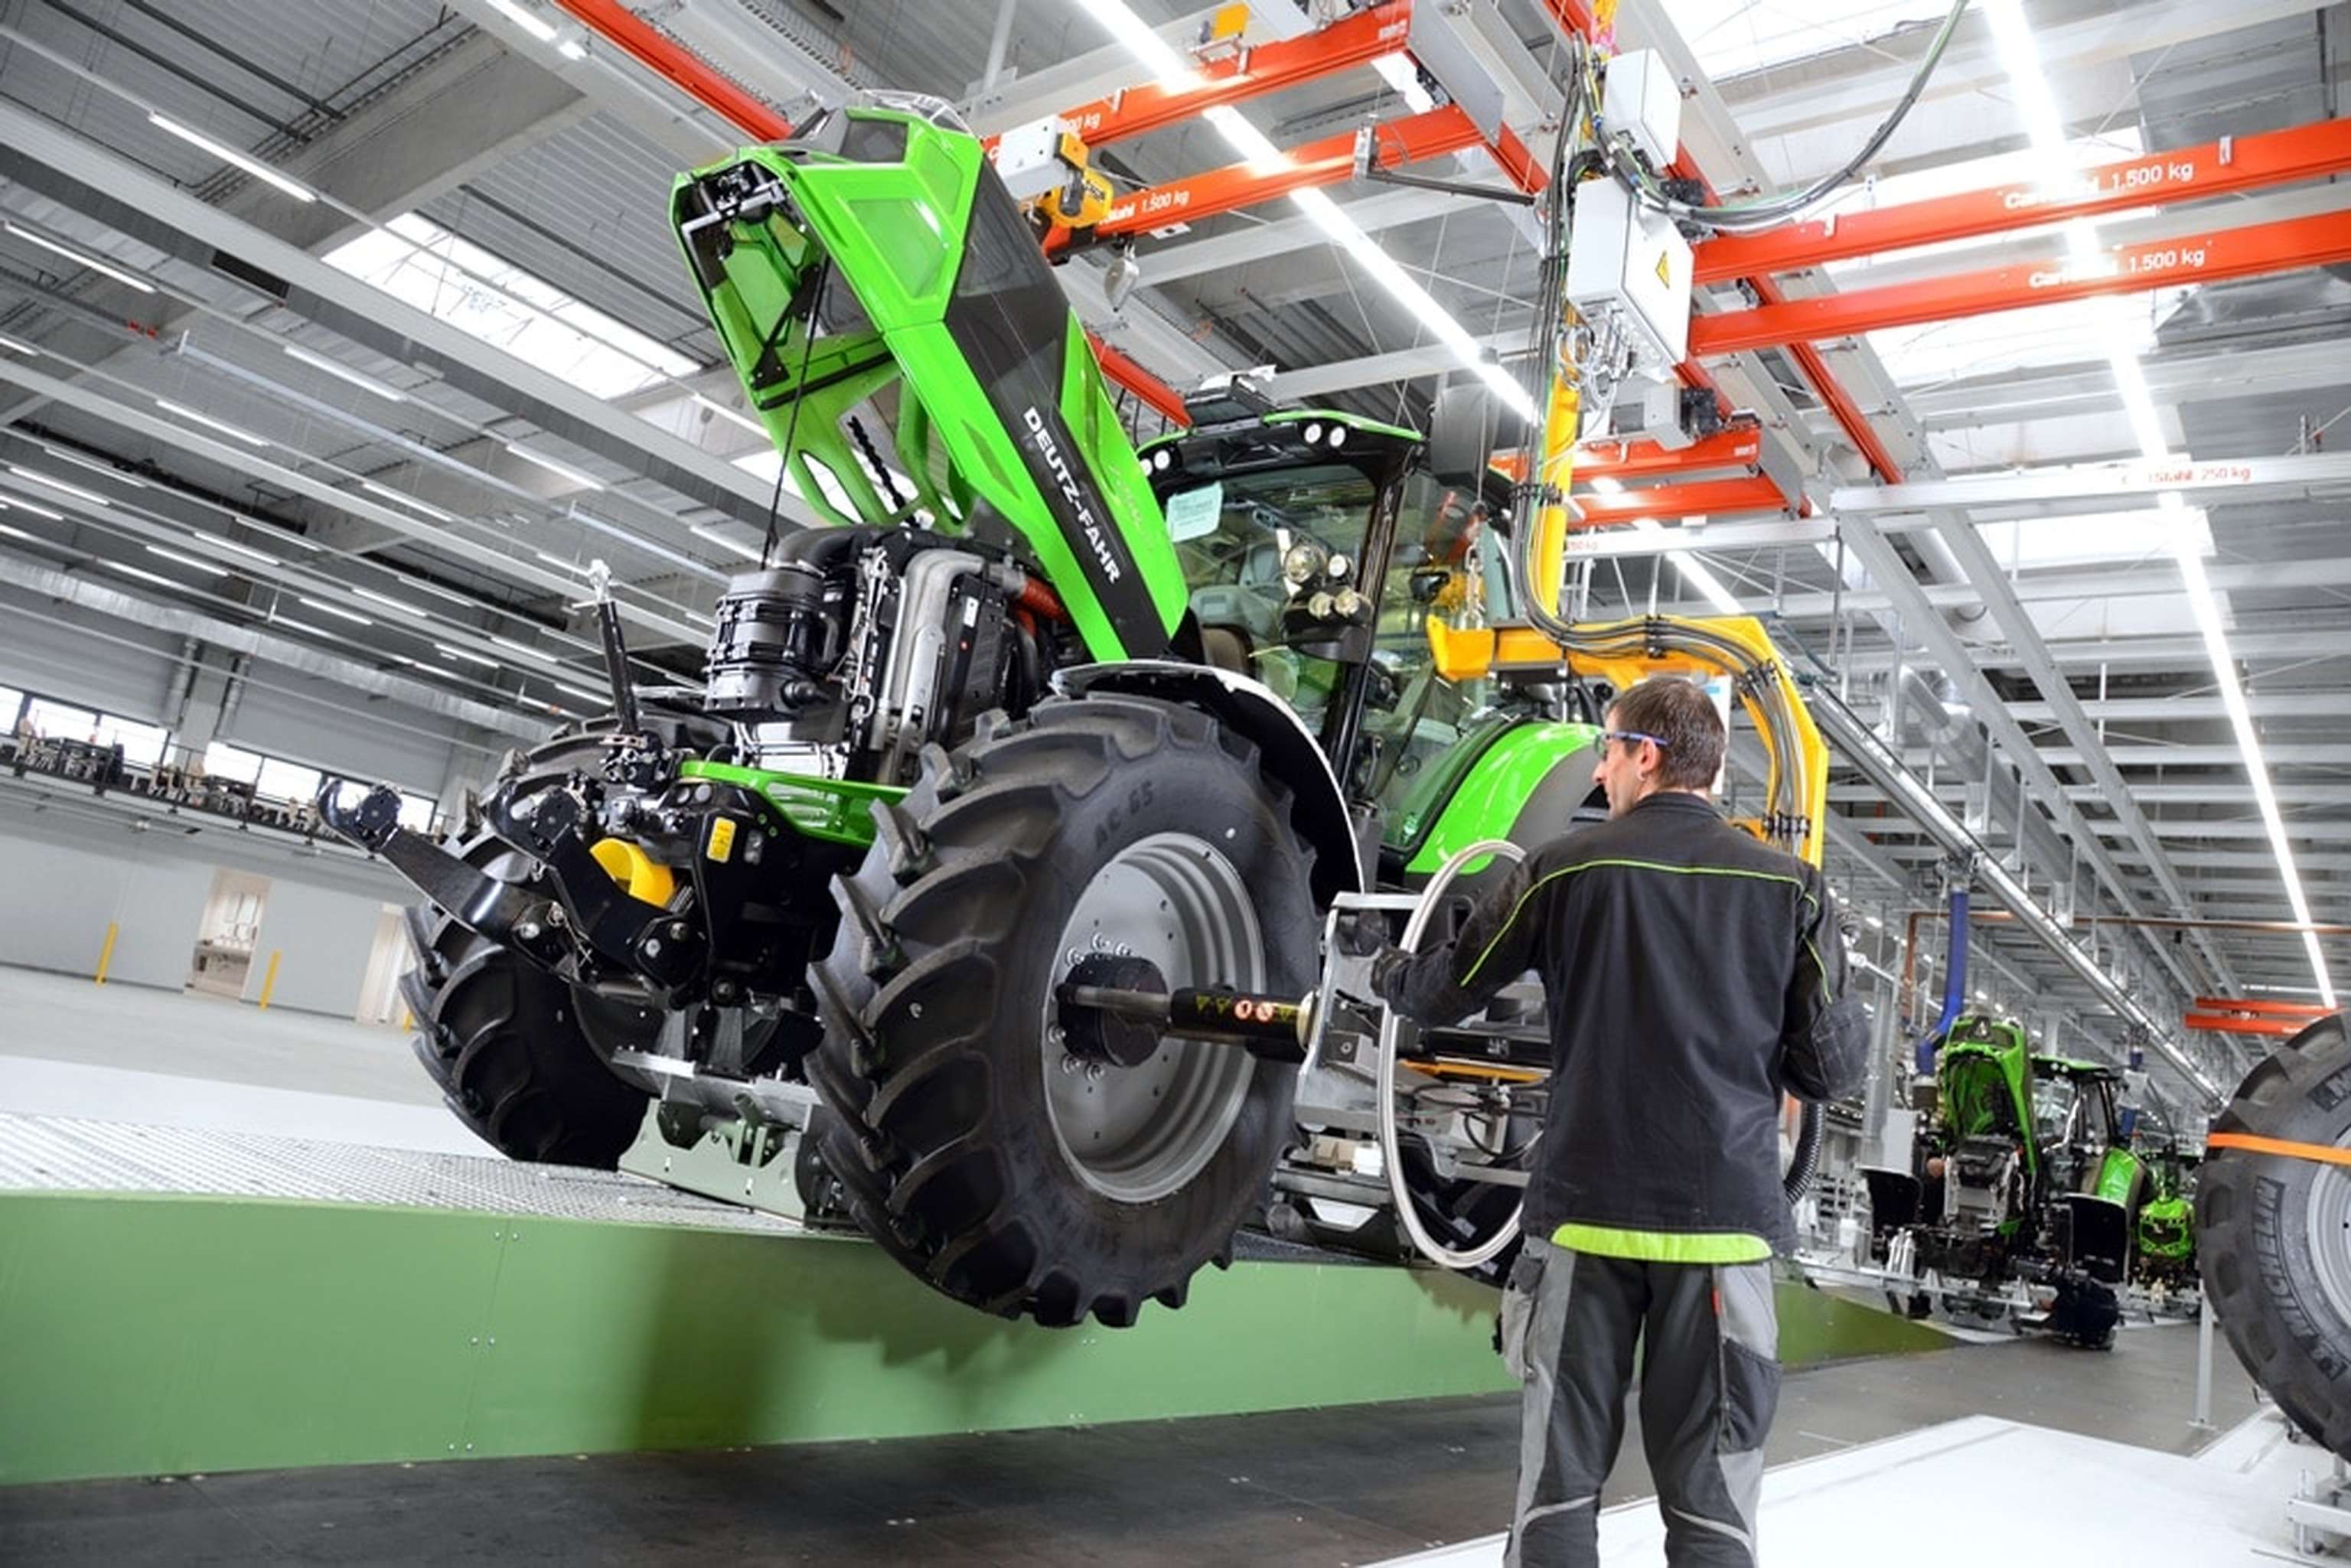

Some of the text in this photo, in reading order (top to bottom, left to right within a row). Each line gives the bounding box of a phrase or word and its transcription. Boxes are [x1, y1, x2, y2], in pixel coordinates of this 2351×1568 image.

[2111, 165, 2163, 191] 1.500
[2168, 161, 2194, 183] kg
[1142, 191, 1172, 214] 1.500
[1173, 191, 1190, 207] kg
[2130, 250, 2177, 274] 1.500
[2182, 247, 2206, 266] kg
[2231, 465, 2252, 482] kg
[1023, 406, 1120, 584] DEUTZ-FAHR
